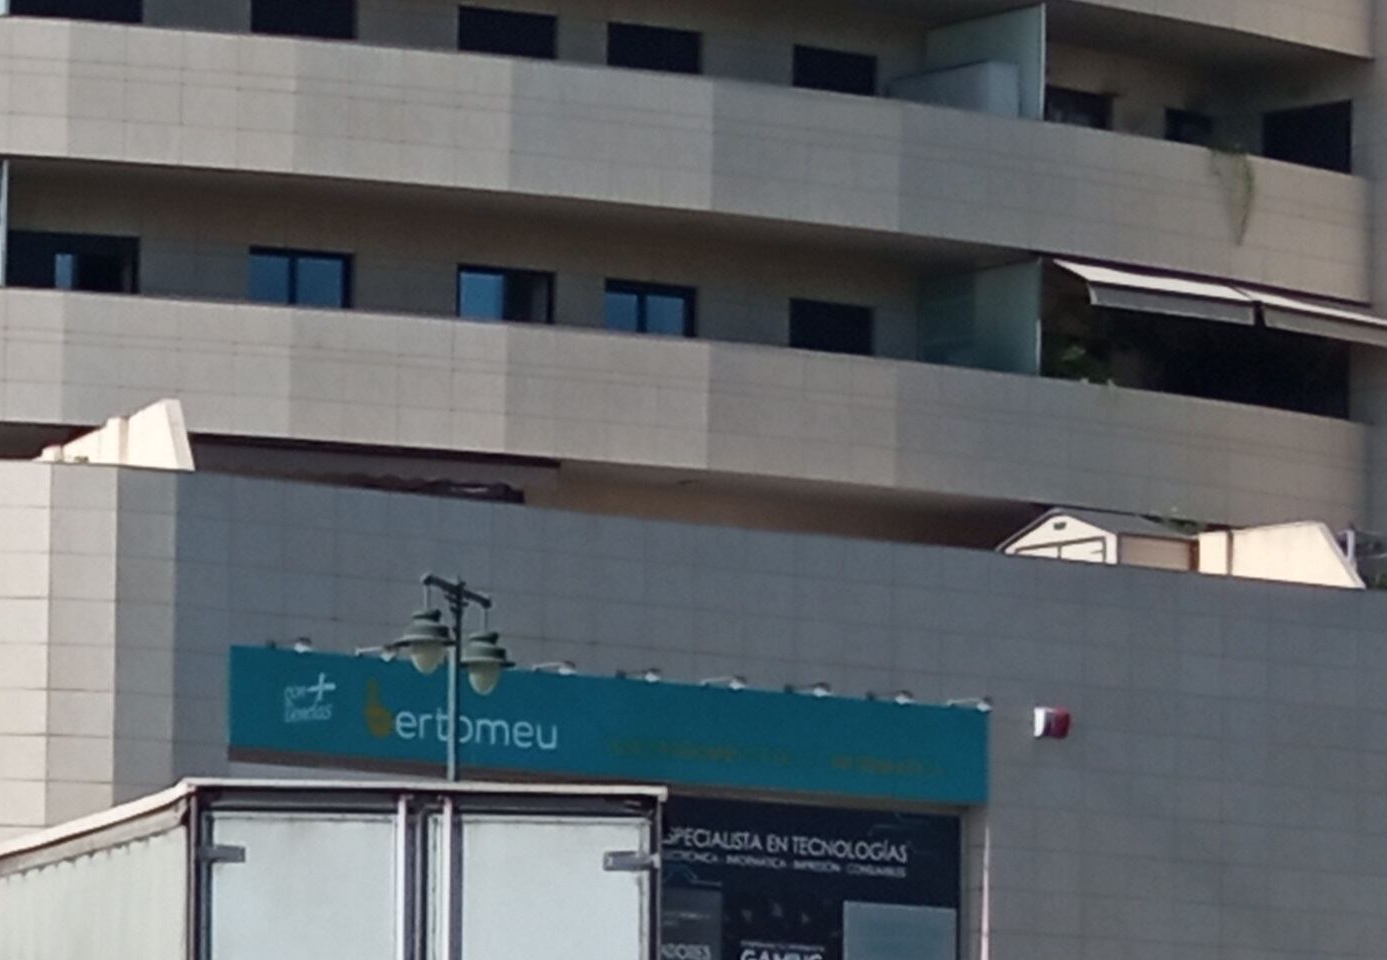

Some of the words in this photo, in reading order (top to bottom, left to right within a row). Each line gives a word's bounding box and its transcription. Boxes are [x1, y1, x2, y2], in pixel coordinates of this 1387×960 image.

[662, 827, 763, 851] SPECIALISTA
[766, 834, 788, 853] EN
[792, 836, 908, 864] TECNOLOGÍAS
